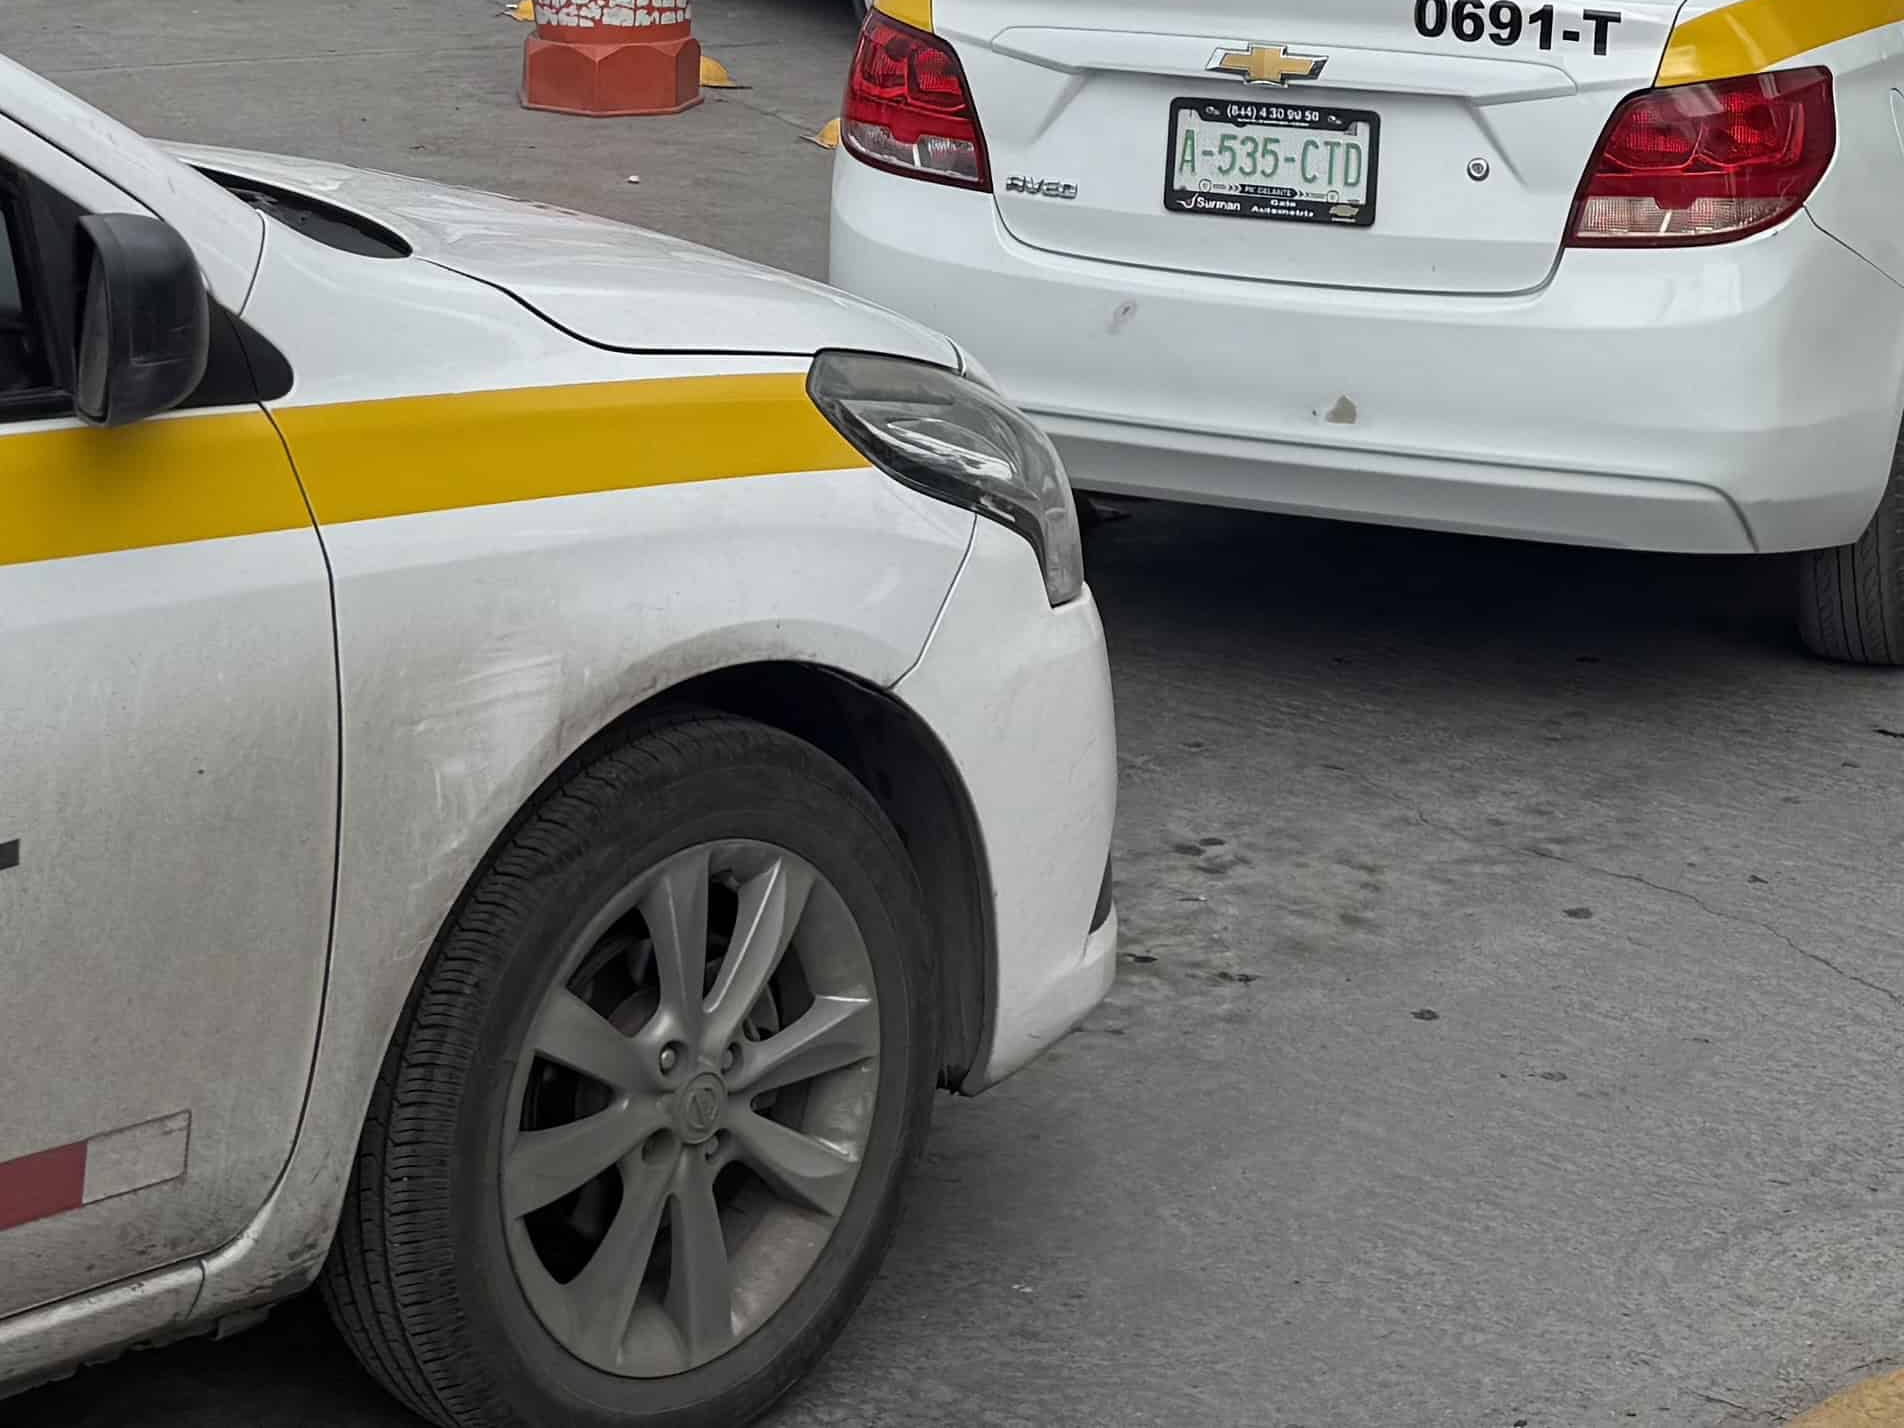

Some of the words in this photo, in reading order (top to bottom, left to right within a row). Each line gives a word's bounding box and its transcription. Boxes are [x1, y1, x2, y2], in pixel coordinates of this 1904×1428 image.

[1226, 103, 1257, 119] (844)
[1259, 106, 1267, 118] 4
[1269, 107, 1284, 119] 30
[1304, 111, 1319, 122] 50
[1179, 129, 1362, 187] A-535-CTD
[1197, 198, 1241, 211] Surman
